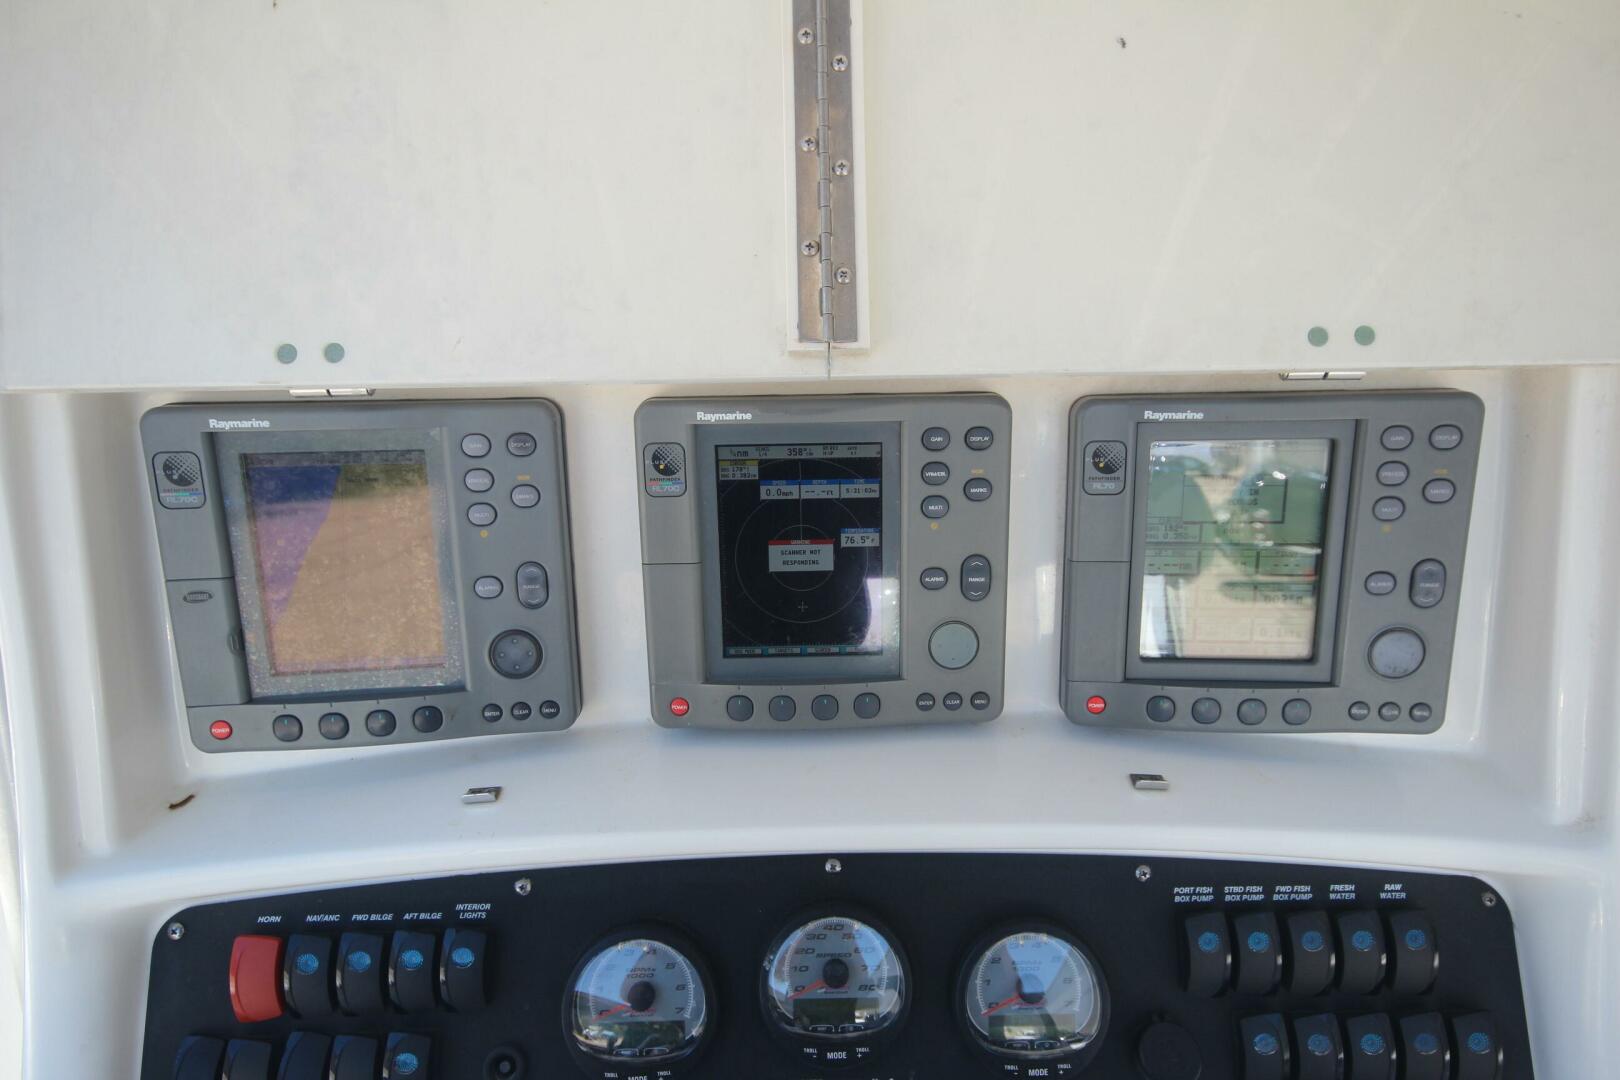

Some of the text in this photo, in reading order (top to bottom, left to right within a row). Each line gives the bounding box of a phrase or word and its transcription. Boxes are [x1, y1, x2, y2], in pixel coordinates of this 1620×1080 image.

[696, 411, 752, 422] Raymarine
[1144, 410, 1204, 421] Raymarine
[209, 418, 270, 430] Raymarine
[1192, 894, 1214, 902] PUMP
[1380, 891, 1406, 899] WATER
[456, 903, 491, 911] INTERIOR
[370, 913, 394, 921] BILGE
[403, 912, 418, 920] AFT
[460, 911, 487, 919] LIGHTS
[257, 915, 282, 924] HORN
[827, 1052, 848, 1060] MODE
[1028, 1068, 1049, 1076] MODE
